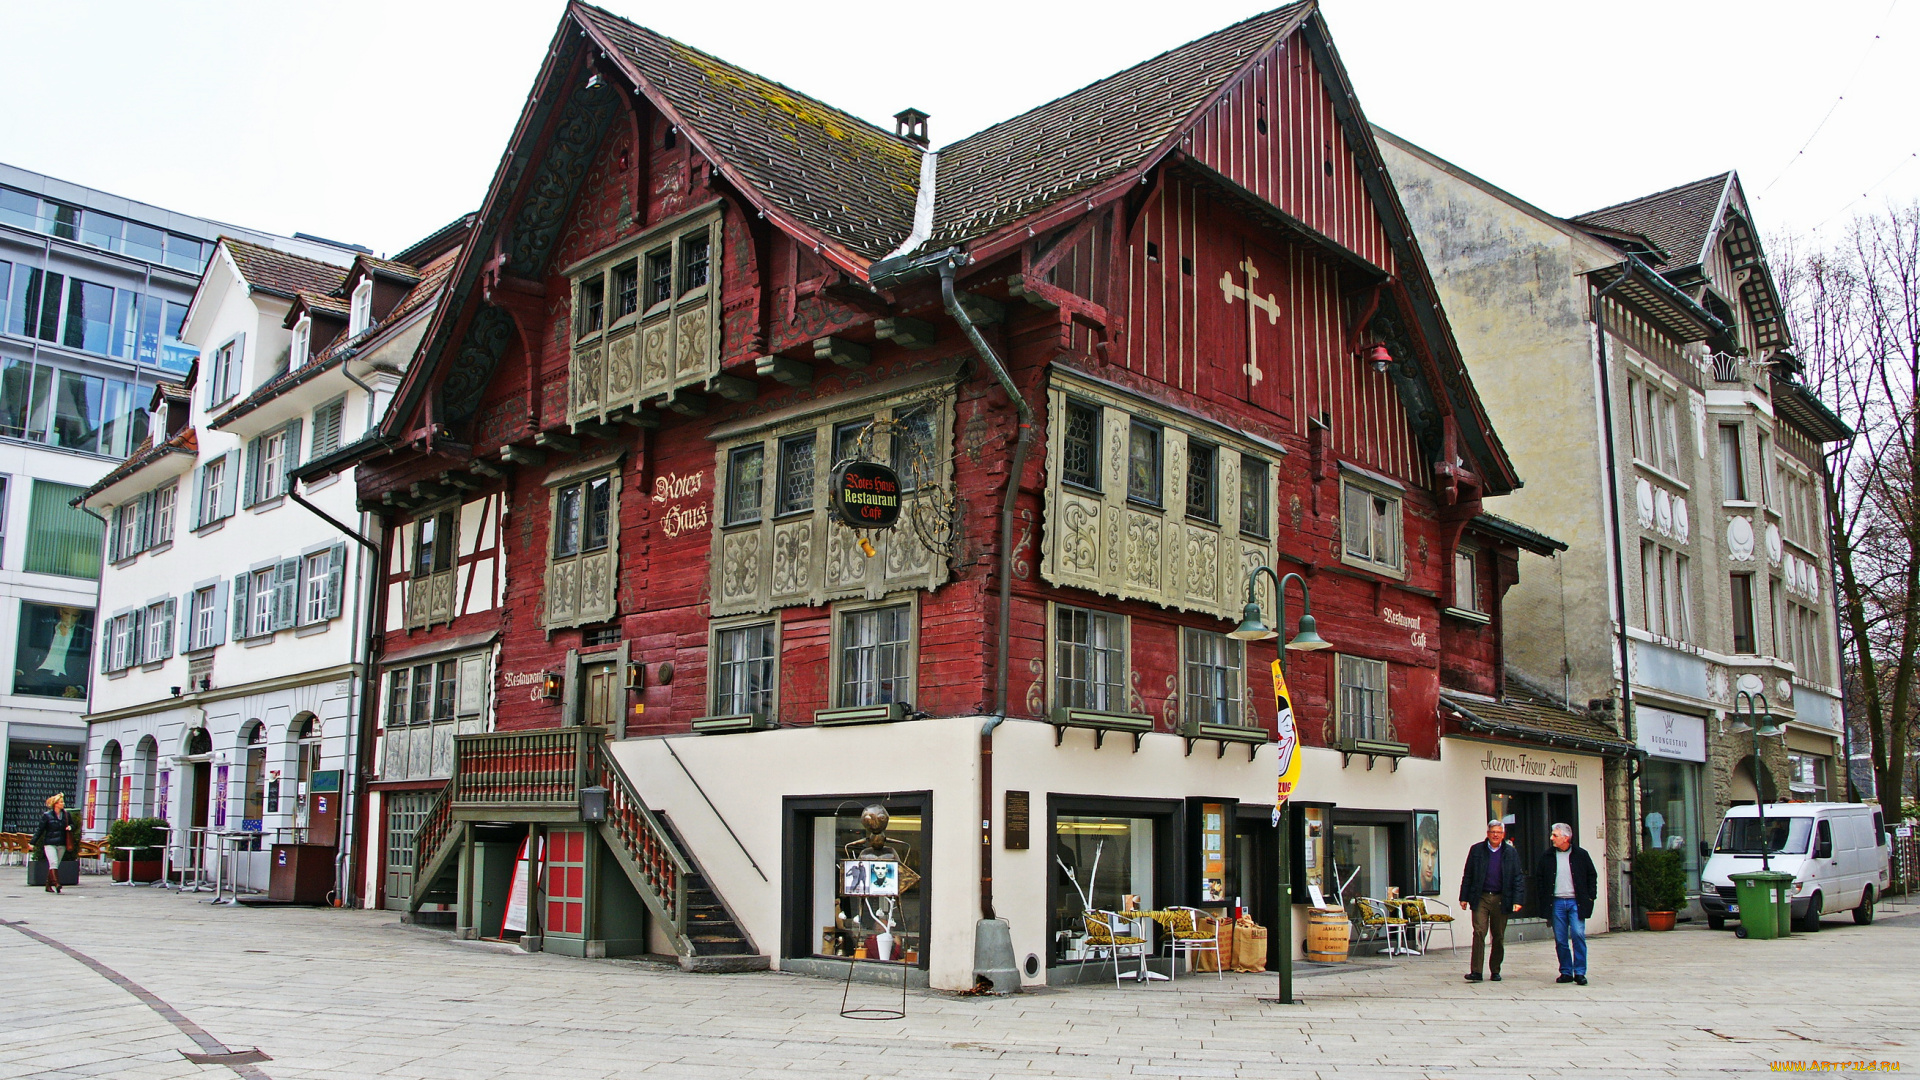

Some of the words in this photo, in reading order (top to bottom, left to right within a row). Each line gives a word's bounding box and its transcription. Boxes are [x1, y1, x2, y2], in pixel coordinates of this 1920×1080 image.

[652, 470, 704, 507] Rotes
[845, 473, 874, 490] Rotes
[874, 476, 896, 493] Haus
[844, 488, 897, 507] Restaurant
[661, 501, 707, 539] Haus
[1383, 607, 1421, 630] Restaurant
[504, 668, 545, 687] Restaurant
[1651, 735, 1688, 748] BUONGUSTAIO
[28, 749, 73, 762] MANGO
[1481, 750, 1547, 776] Herren-Friseur
[1549, 758, 1578, 779] Zanetti
